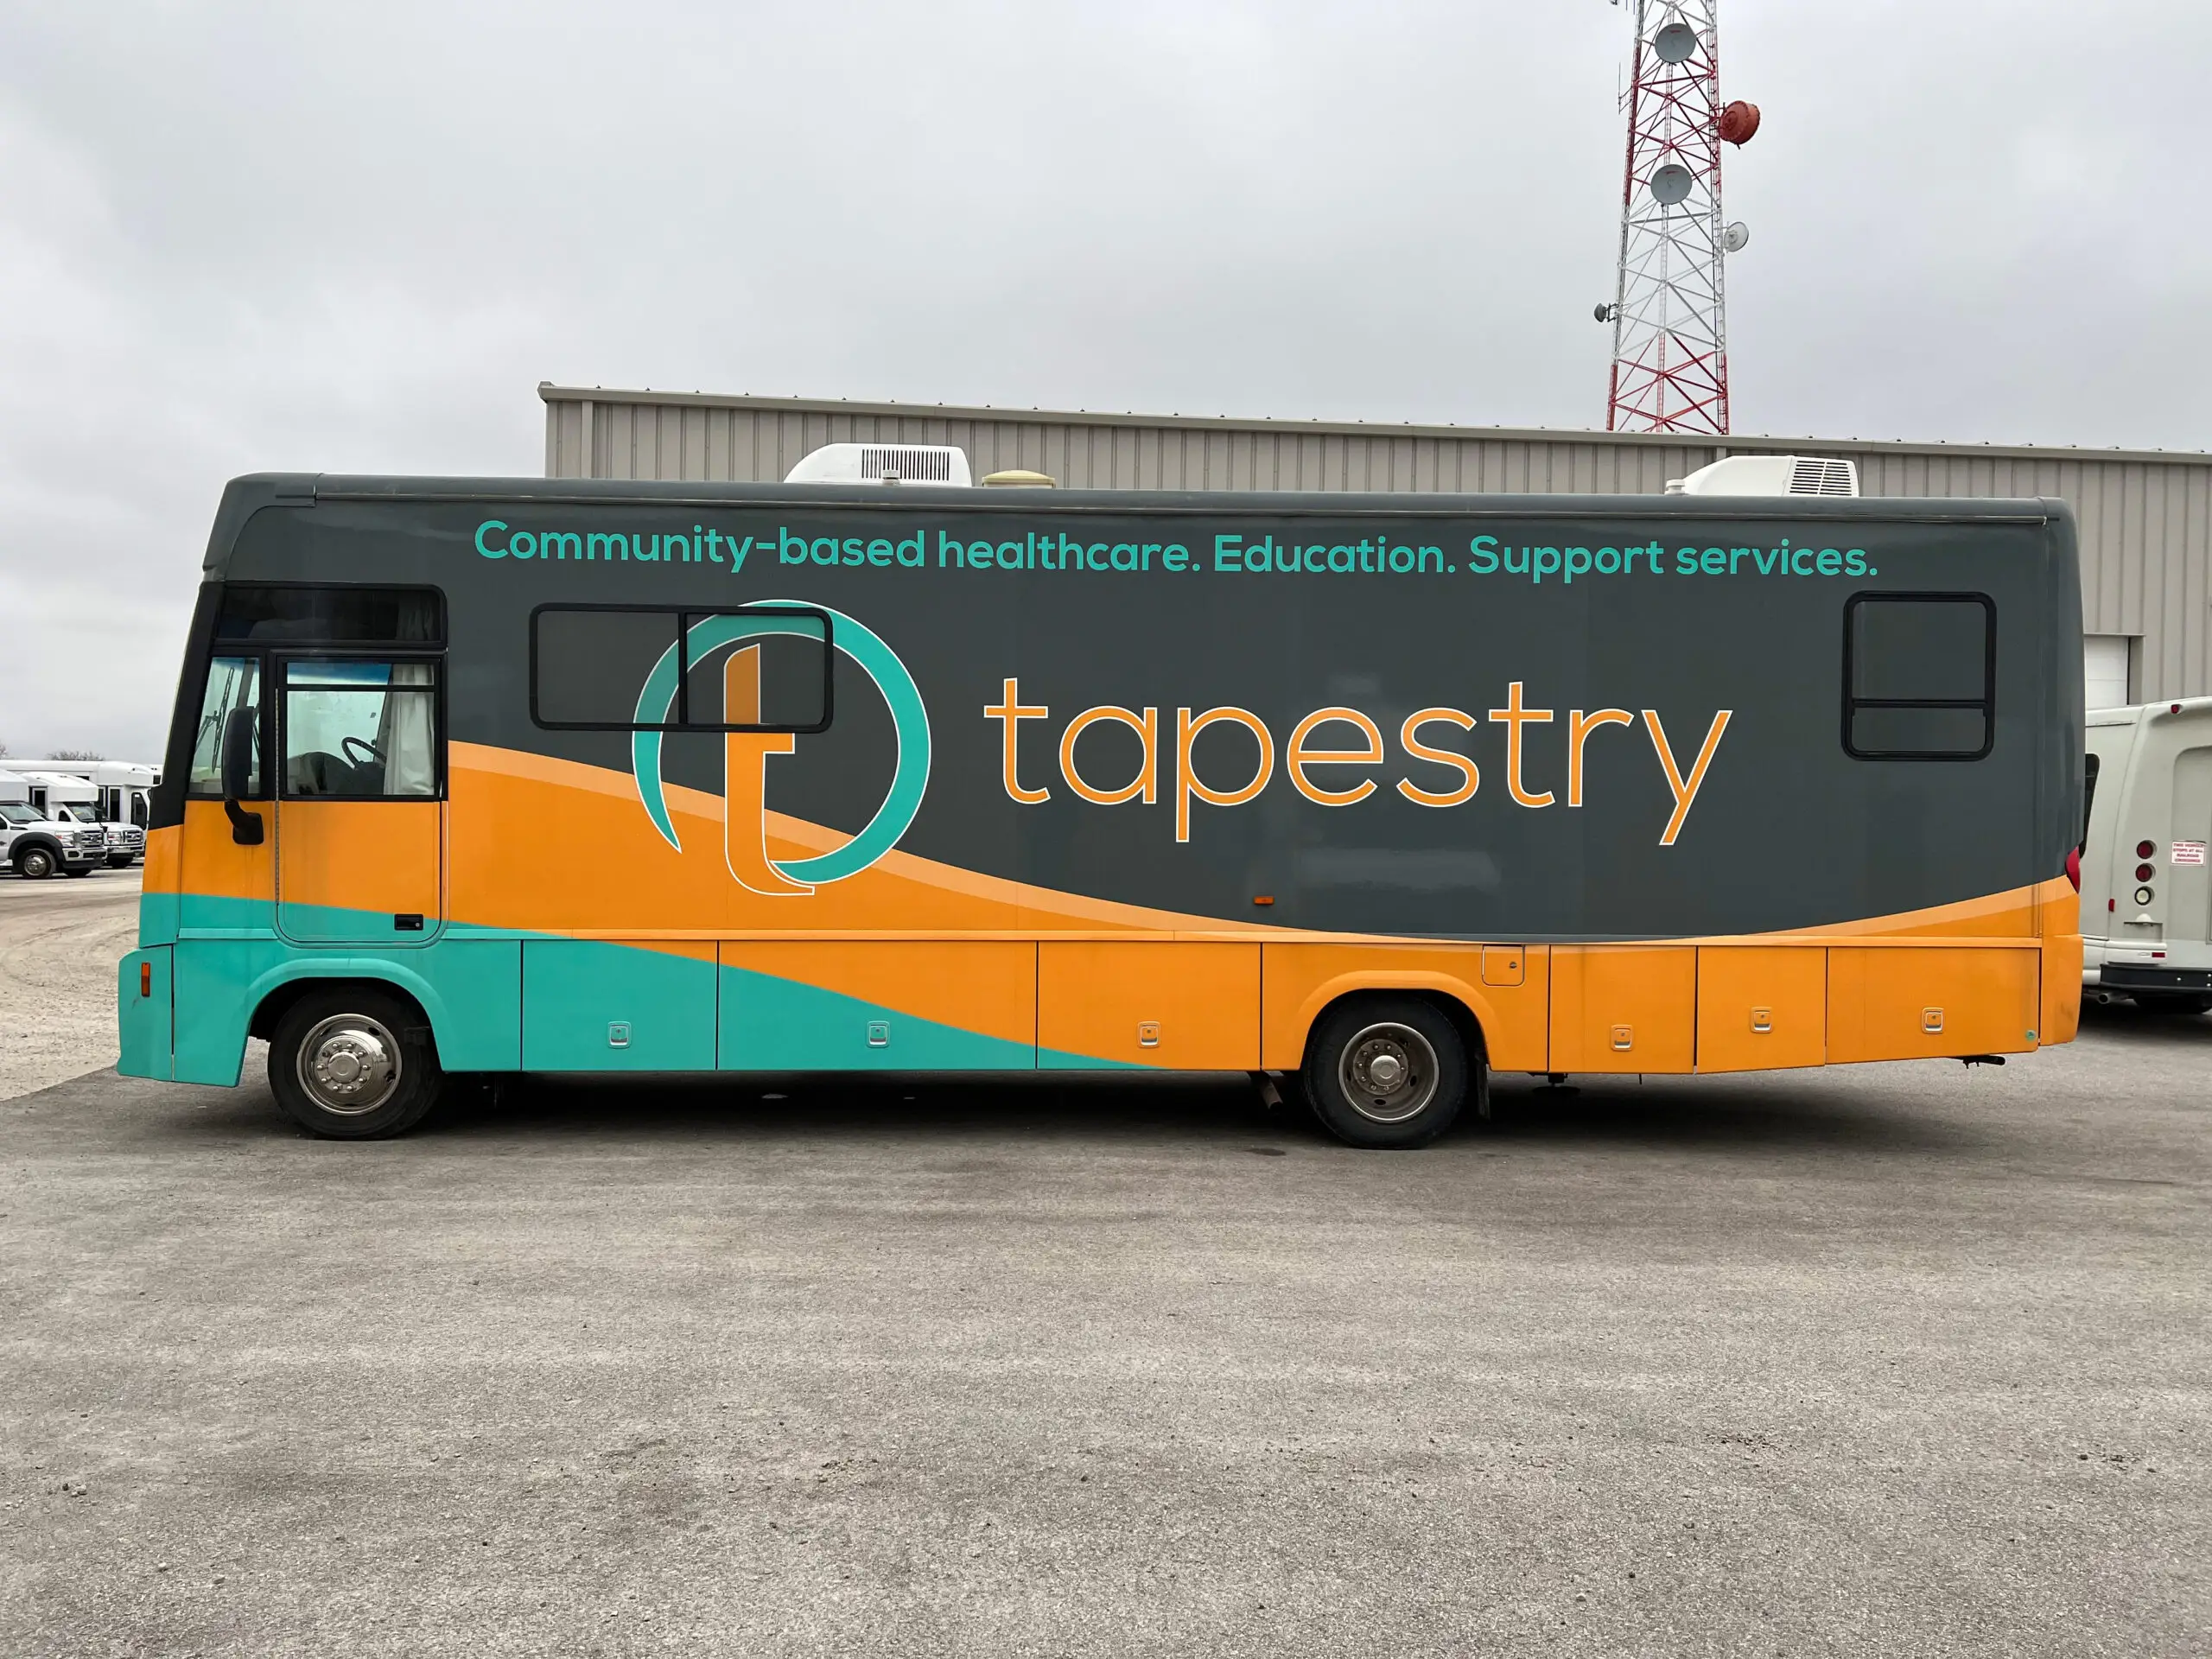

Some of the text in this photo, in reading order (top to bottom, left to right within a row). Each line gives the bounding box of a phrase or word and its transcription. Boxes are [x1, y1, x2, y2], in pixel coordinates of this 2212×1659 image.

[474, 519, 1878, 585] Community-based healthcare. Education. Support services.
[983, 677, 1733, 846] tapestry
